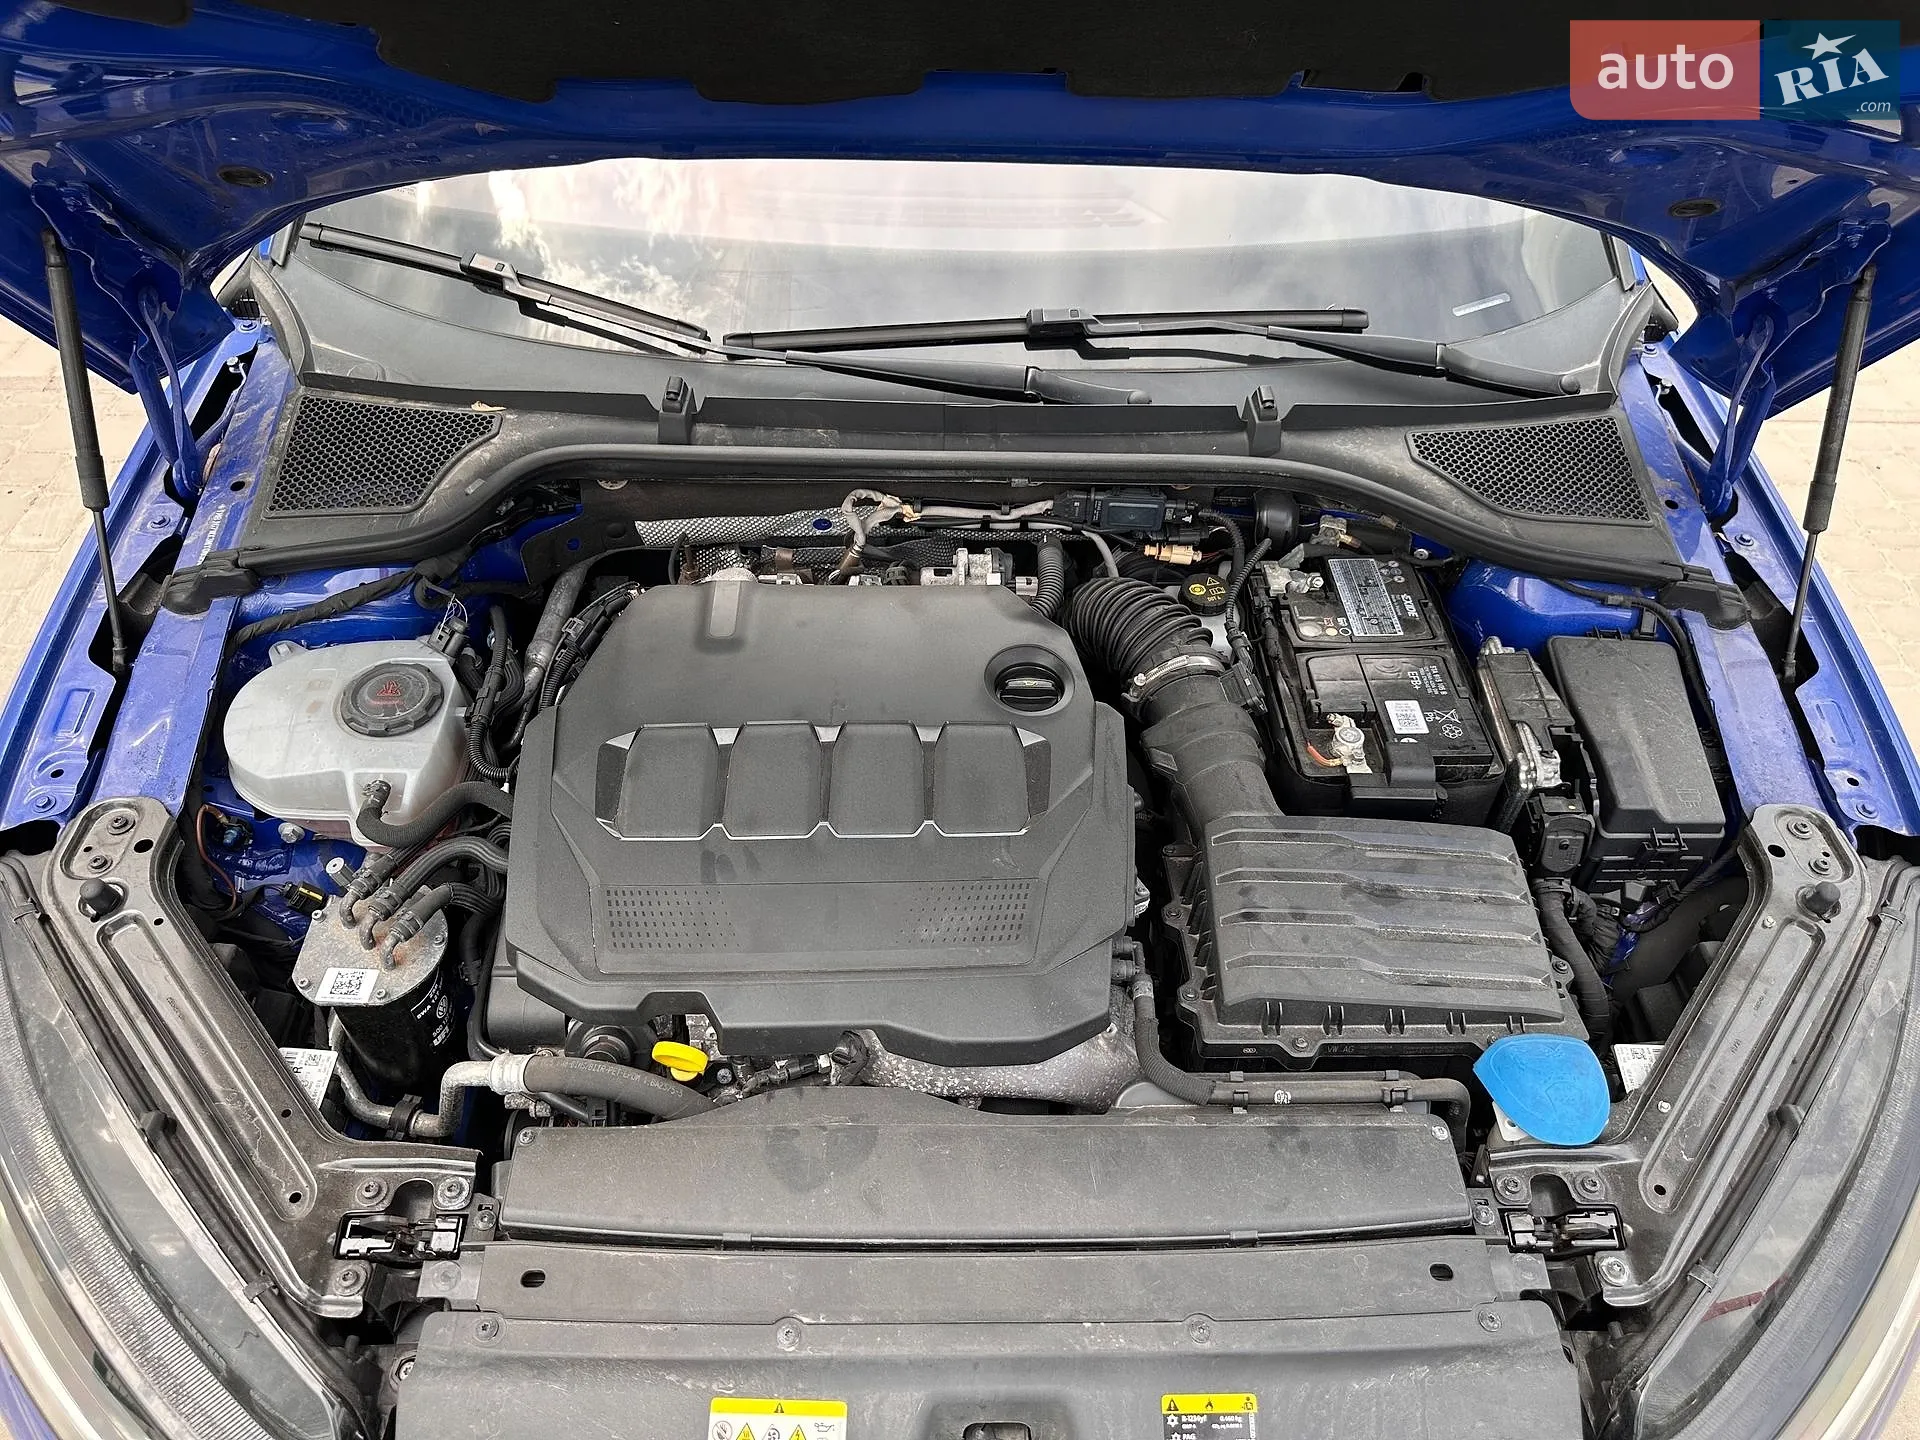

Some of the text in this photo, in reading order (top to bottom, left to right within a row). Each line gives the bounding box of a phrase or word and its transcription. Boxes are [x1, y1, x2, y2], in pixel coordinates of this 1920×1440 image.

[1401, 594, 1419, 617] EXIDE
[1407, 671, 1421, 690] EFB+
[1424, 711, 1435, 722] Pb
